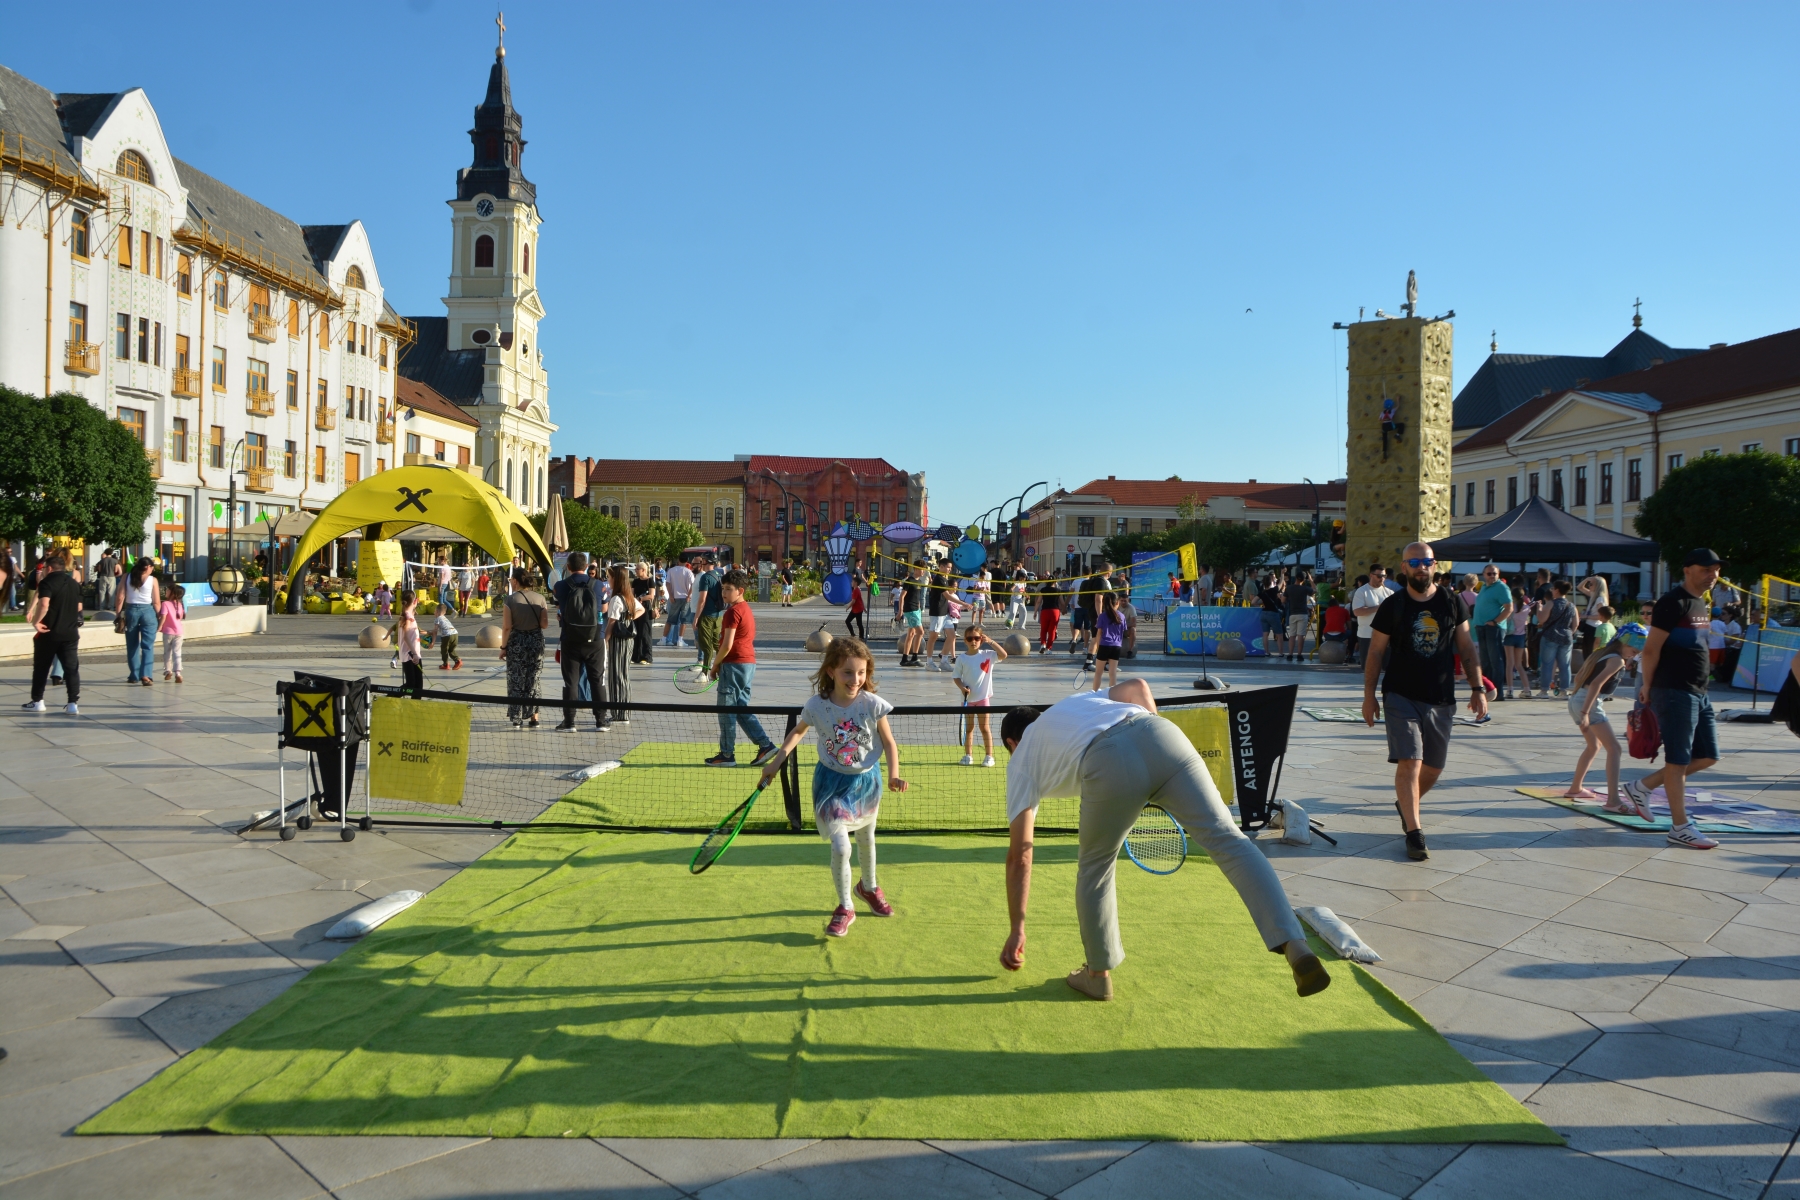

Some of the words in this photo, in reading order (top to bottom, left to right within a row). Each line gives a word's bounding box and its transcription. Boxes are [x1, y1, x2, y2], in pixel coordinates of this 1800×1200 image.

[1317, 560, 1324, 568] P
[824, 583, 830, 592] 8
[1181, 621, 1222, 629] ESCALADĂ
[402, 740, 459, 754] Raiffeisen
[1237, 711, 1257, 790] ARTENGO
[401, 752, 430, 764] Bank
